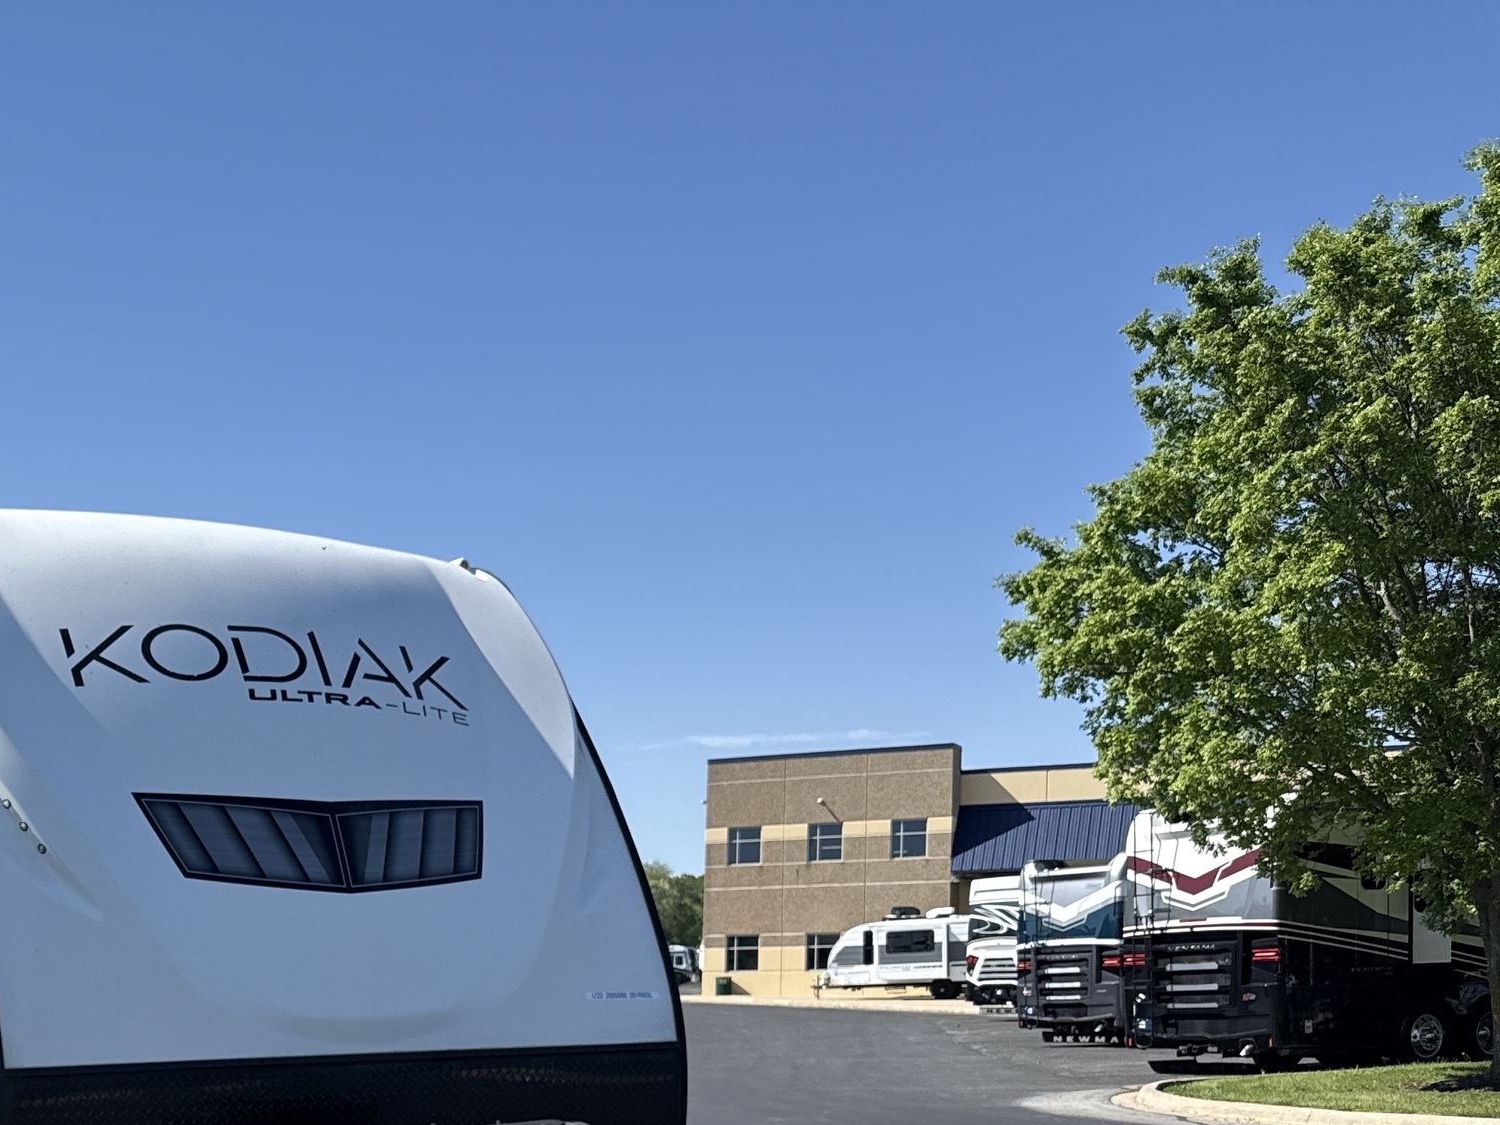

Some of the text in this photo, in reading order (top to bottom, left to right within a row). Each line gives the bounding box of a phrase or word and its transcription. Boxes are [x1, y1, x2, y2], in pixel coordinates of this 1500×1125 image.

[59, 624, 468, 711] KODIAK
[248, 688, 469, 727] ULTRA-LITE
[1053, 1035, 1125, 1043] NEWMA
